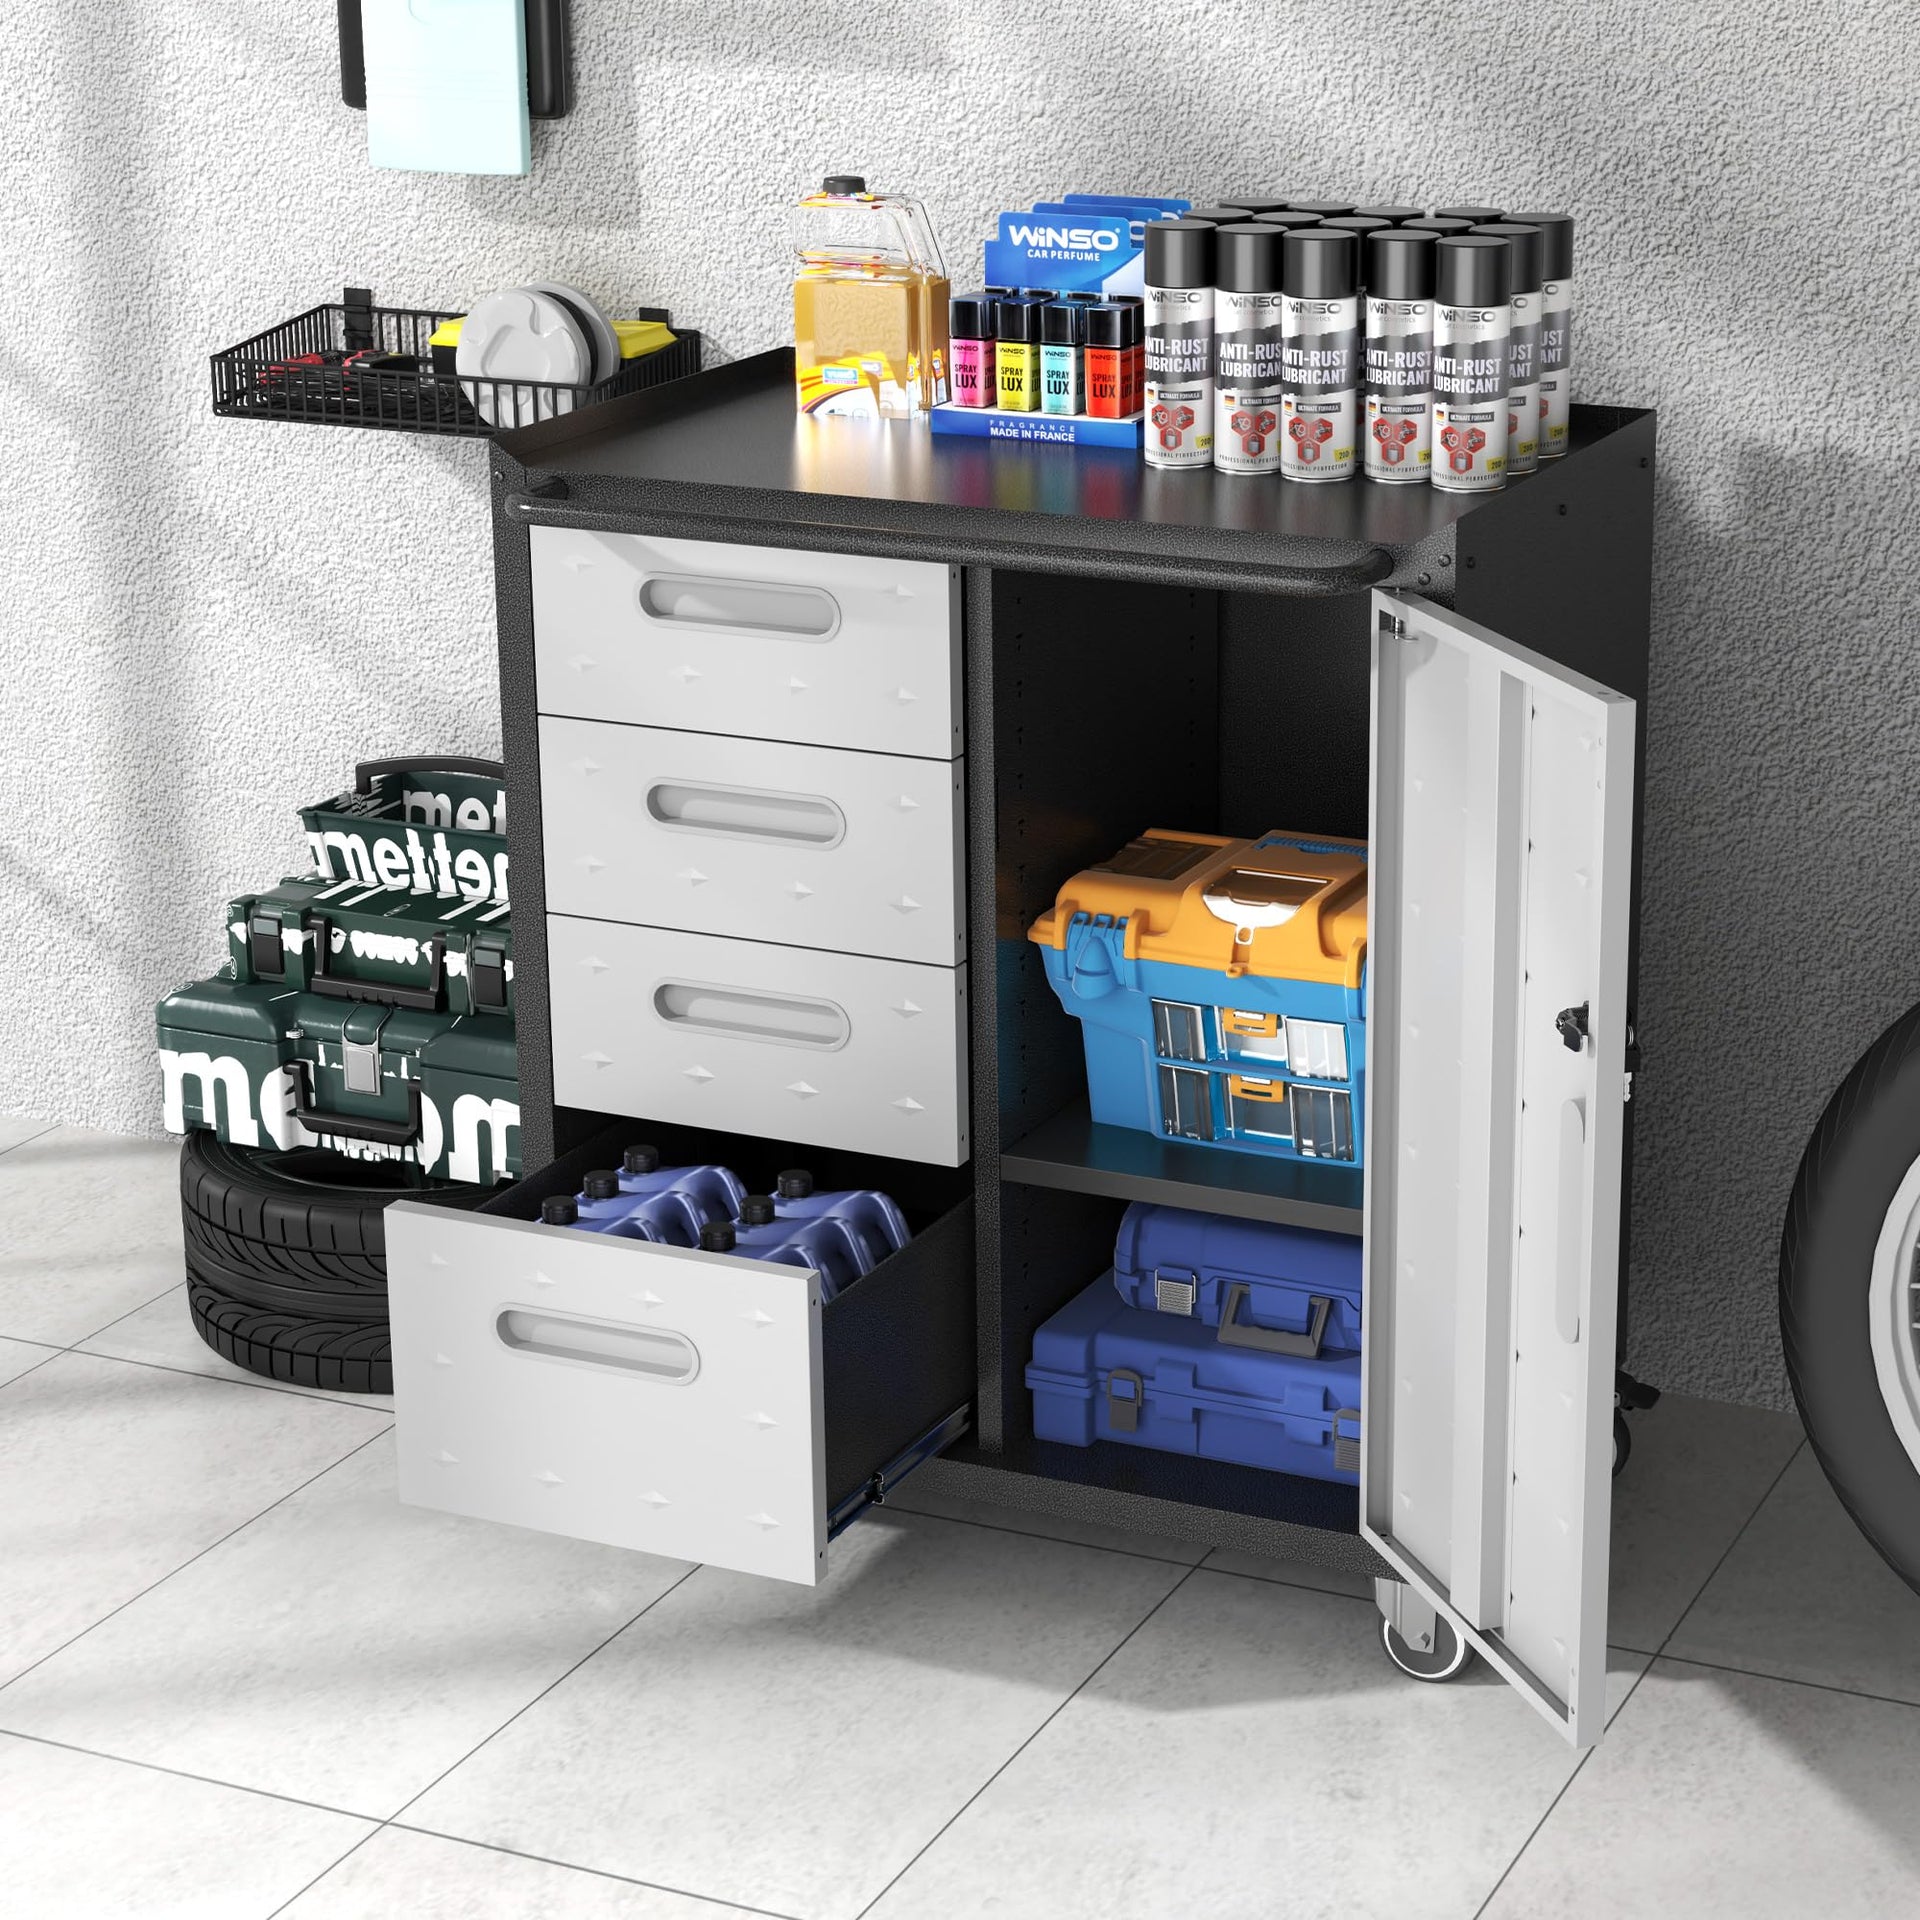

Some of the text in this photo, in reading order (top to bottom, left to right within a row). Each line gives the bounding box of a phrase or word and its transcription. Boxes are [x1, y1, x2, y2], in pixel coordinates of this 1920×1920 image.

[1027, 249, 1101, 262] CAR PERFUME
[1145, 335, 1208, 355] ANTI-RUST
[1220, 342, 1282, 360] ANTI-RUS
[1145, 353, 1208, 373] LUBRICANT
[1282, 346, 1348, 367] ANTI-RUST
[1367, 348, 1432, 368] ANTI-RUST
[954, 363, 977, 373] SPRAY
[1001, 366, 1023, 376] SPRAY
[1221, 360, 1281, 378] LUBRICAN
[1434, 355, 1502, 376] ANTI-RUST
[955, 374, 977, 388] LUX
[1046, 369, 1069, 379] SPRAY
[1092, 373, 1116, 383] SPRAY
[1282, 365, 1347, 385] LUBRICANT
[1367, 366, 1431, 385] LUBRICANT
[1001, 376, 1023, 392] LUX
[1047, 380, 1070, 395] LUX
[1093, 383, 1116, 399] LUX
[1434, 374, 1500, 394] LUBRICANT
[990, 419, 1075, 432] FRAGRANCE
[990, 427, 1075, 442] MADE IN FRANCE
